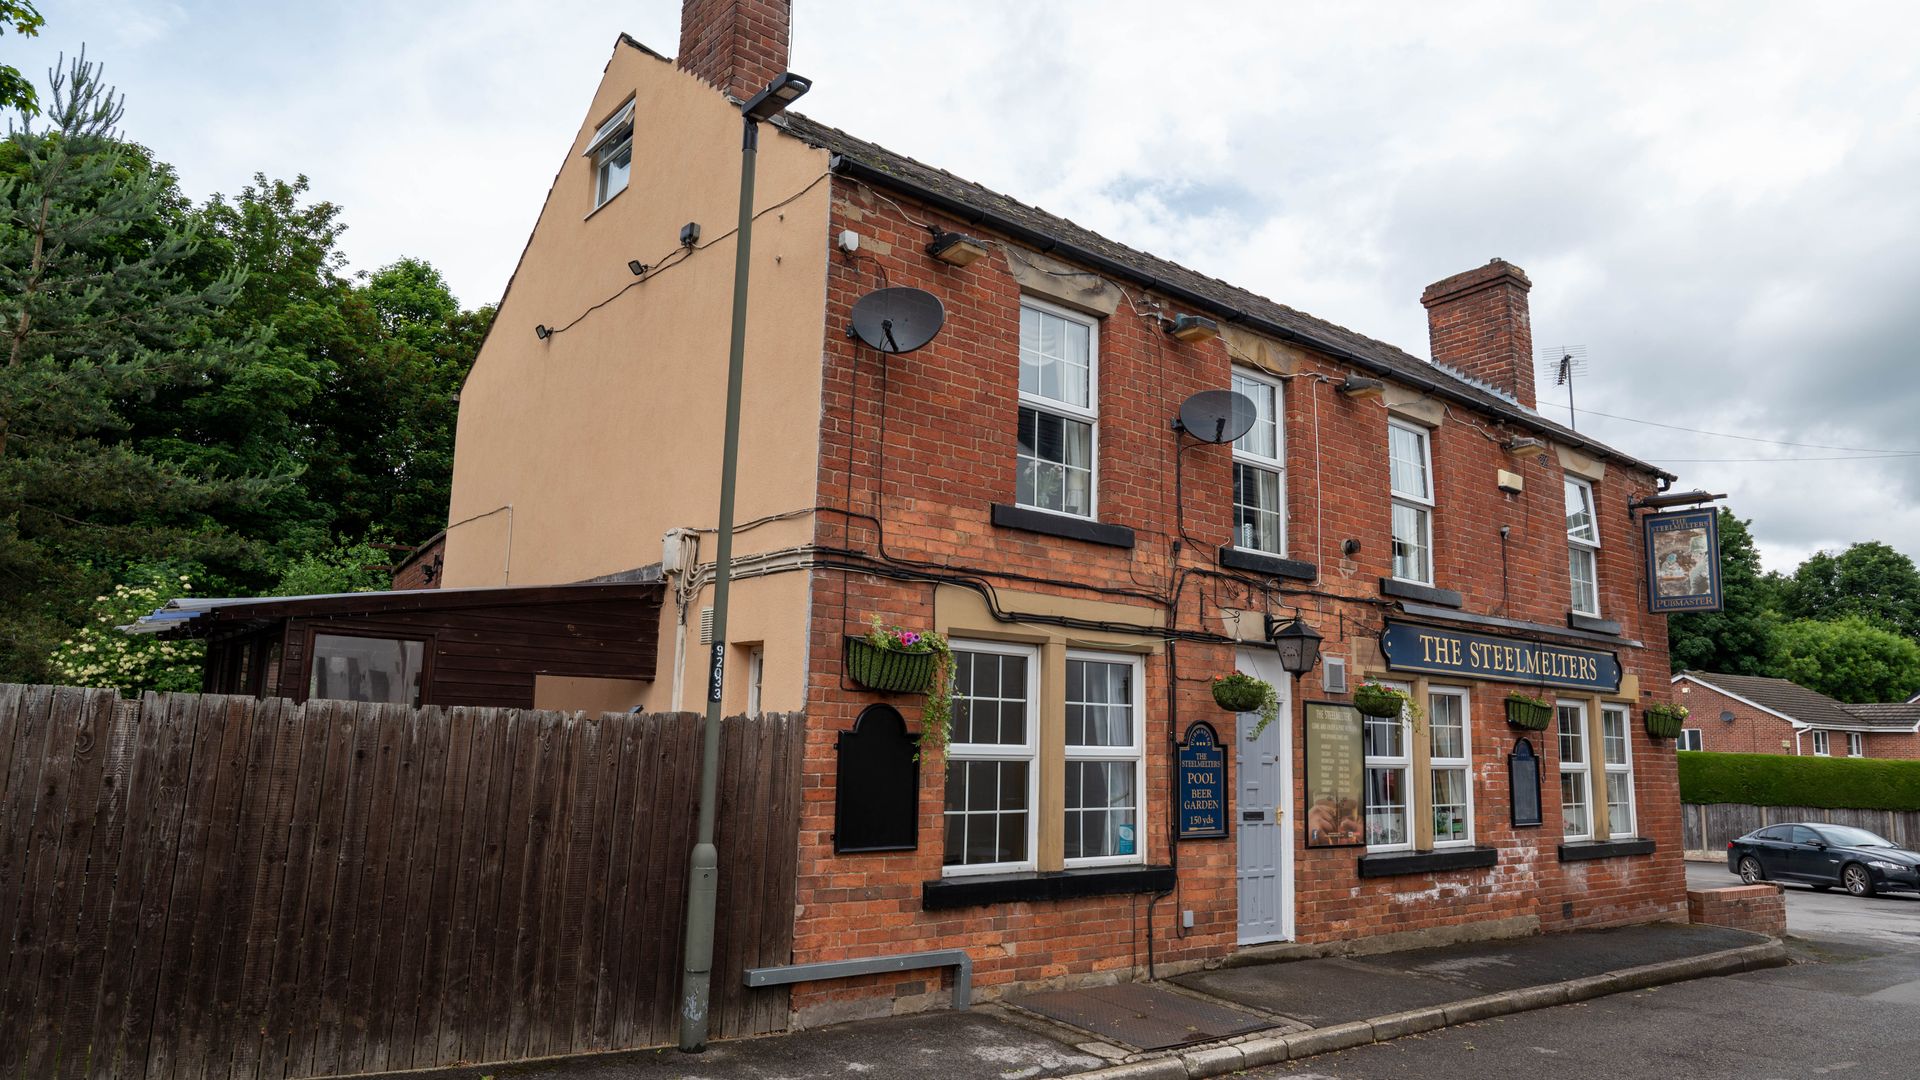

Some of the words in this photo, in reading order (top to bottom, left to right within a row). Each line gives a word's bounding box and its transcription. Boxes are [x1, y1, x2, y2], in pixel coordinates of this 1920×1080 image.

[1656, 596, 1713, 608] PUBMASTER
[1419, 634, 1463, 667] THE
[1470, 641, 1598, 682] STEELMELTERS
[713, 645, 724, 699] 92033
[1195, 752, 1208, 761] THE
[1181, 760, 1221, 768] STEELMELTERS
[1187, 772, 1216, 785] POOL
[1191, 788, 1213, 799] BEER
[1184, 800, 1219, 810] GARDEN
[1190, 815, 1202, 825] 150
[1202, 814, 1215, 826] yds
